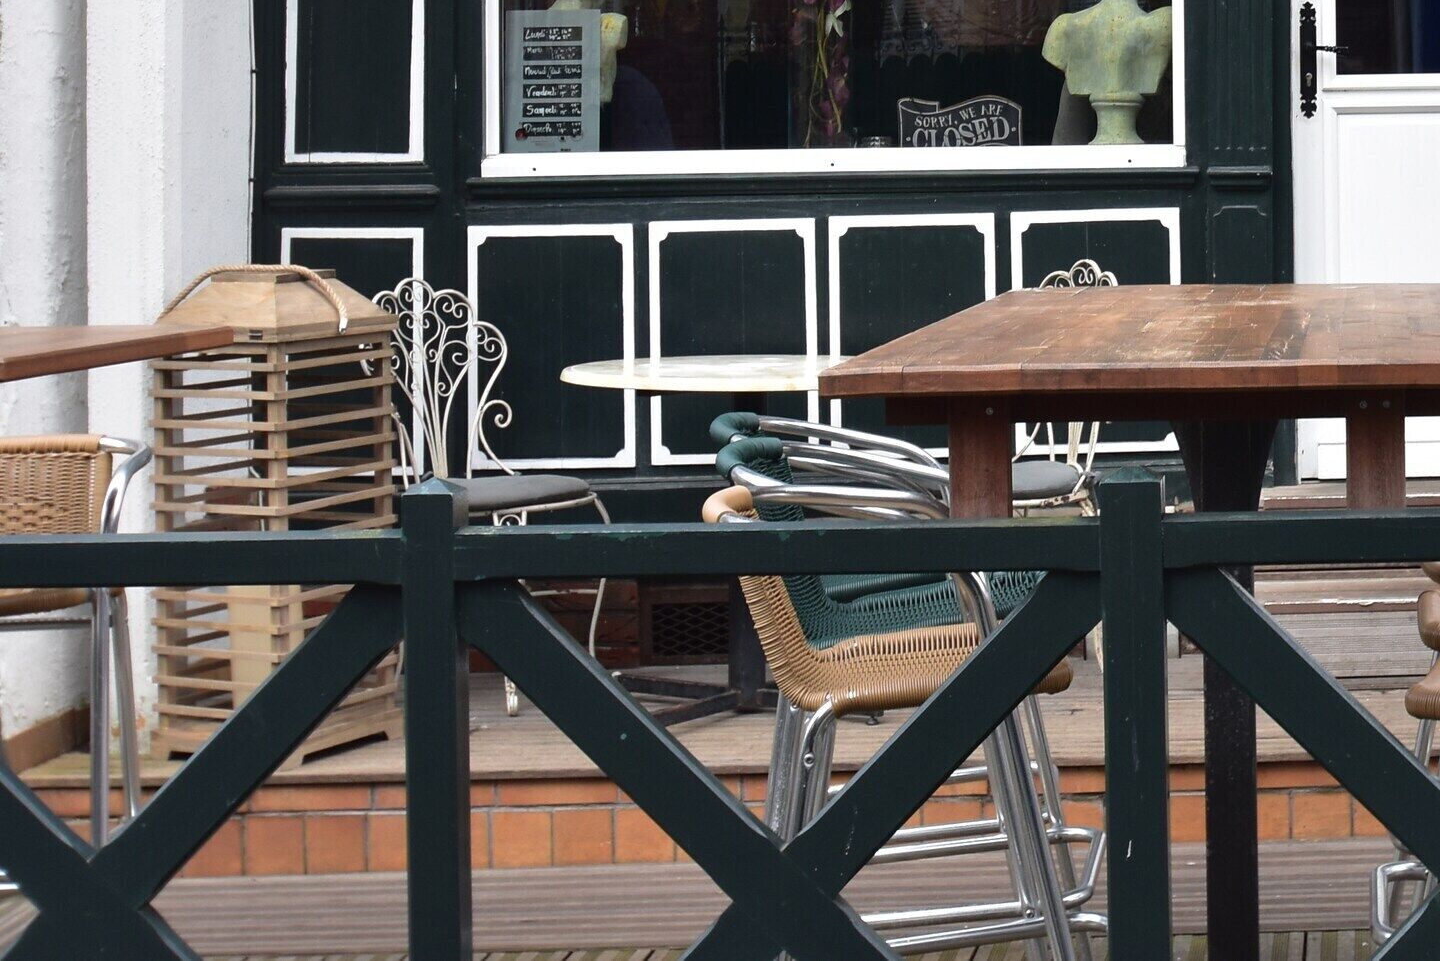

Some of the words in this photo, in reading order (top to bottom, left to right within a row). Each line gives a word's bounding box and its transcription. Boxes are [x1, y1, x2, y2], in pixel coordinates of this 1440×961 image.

[959, 106, 977, 121] WE
[980, 104, 1004, 116] ARE
[912, 116, 1010, 147] CLOSED
